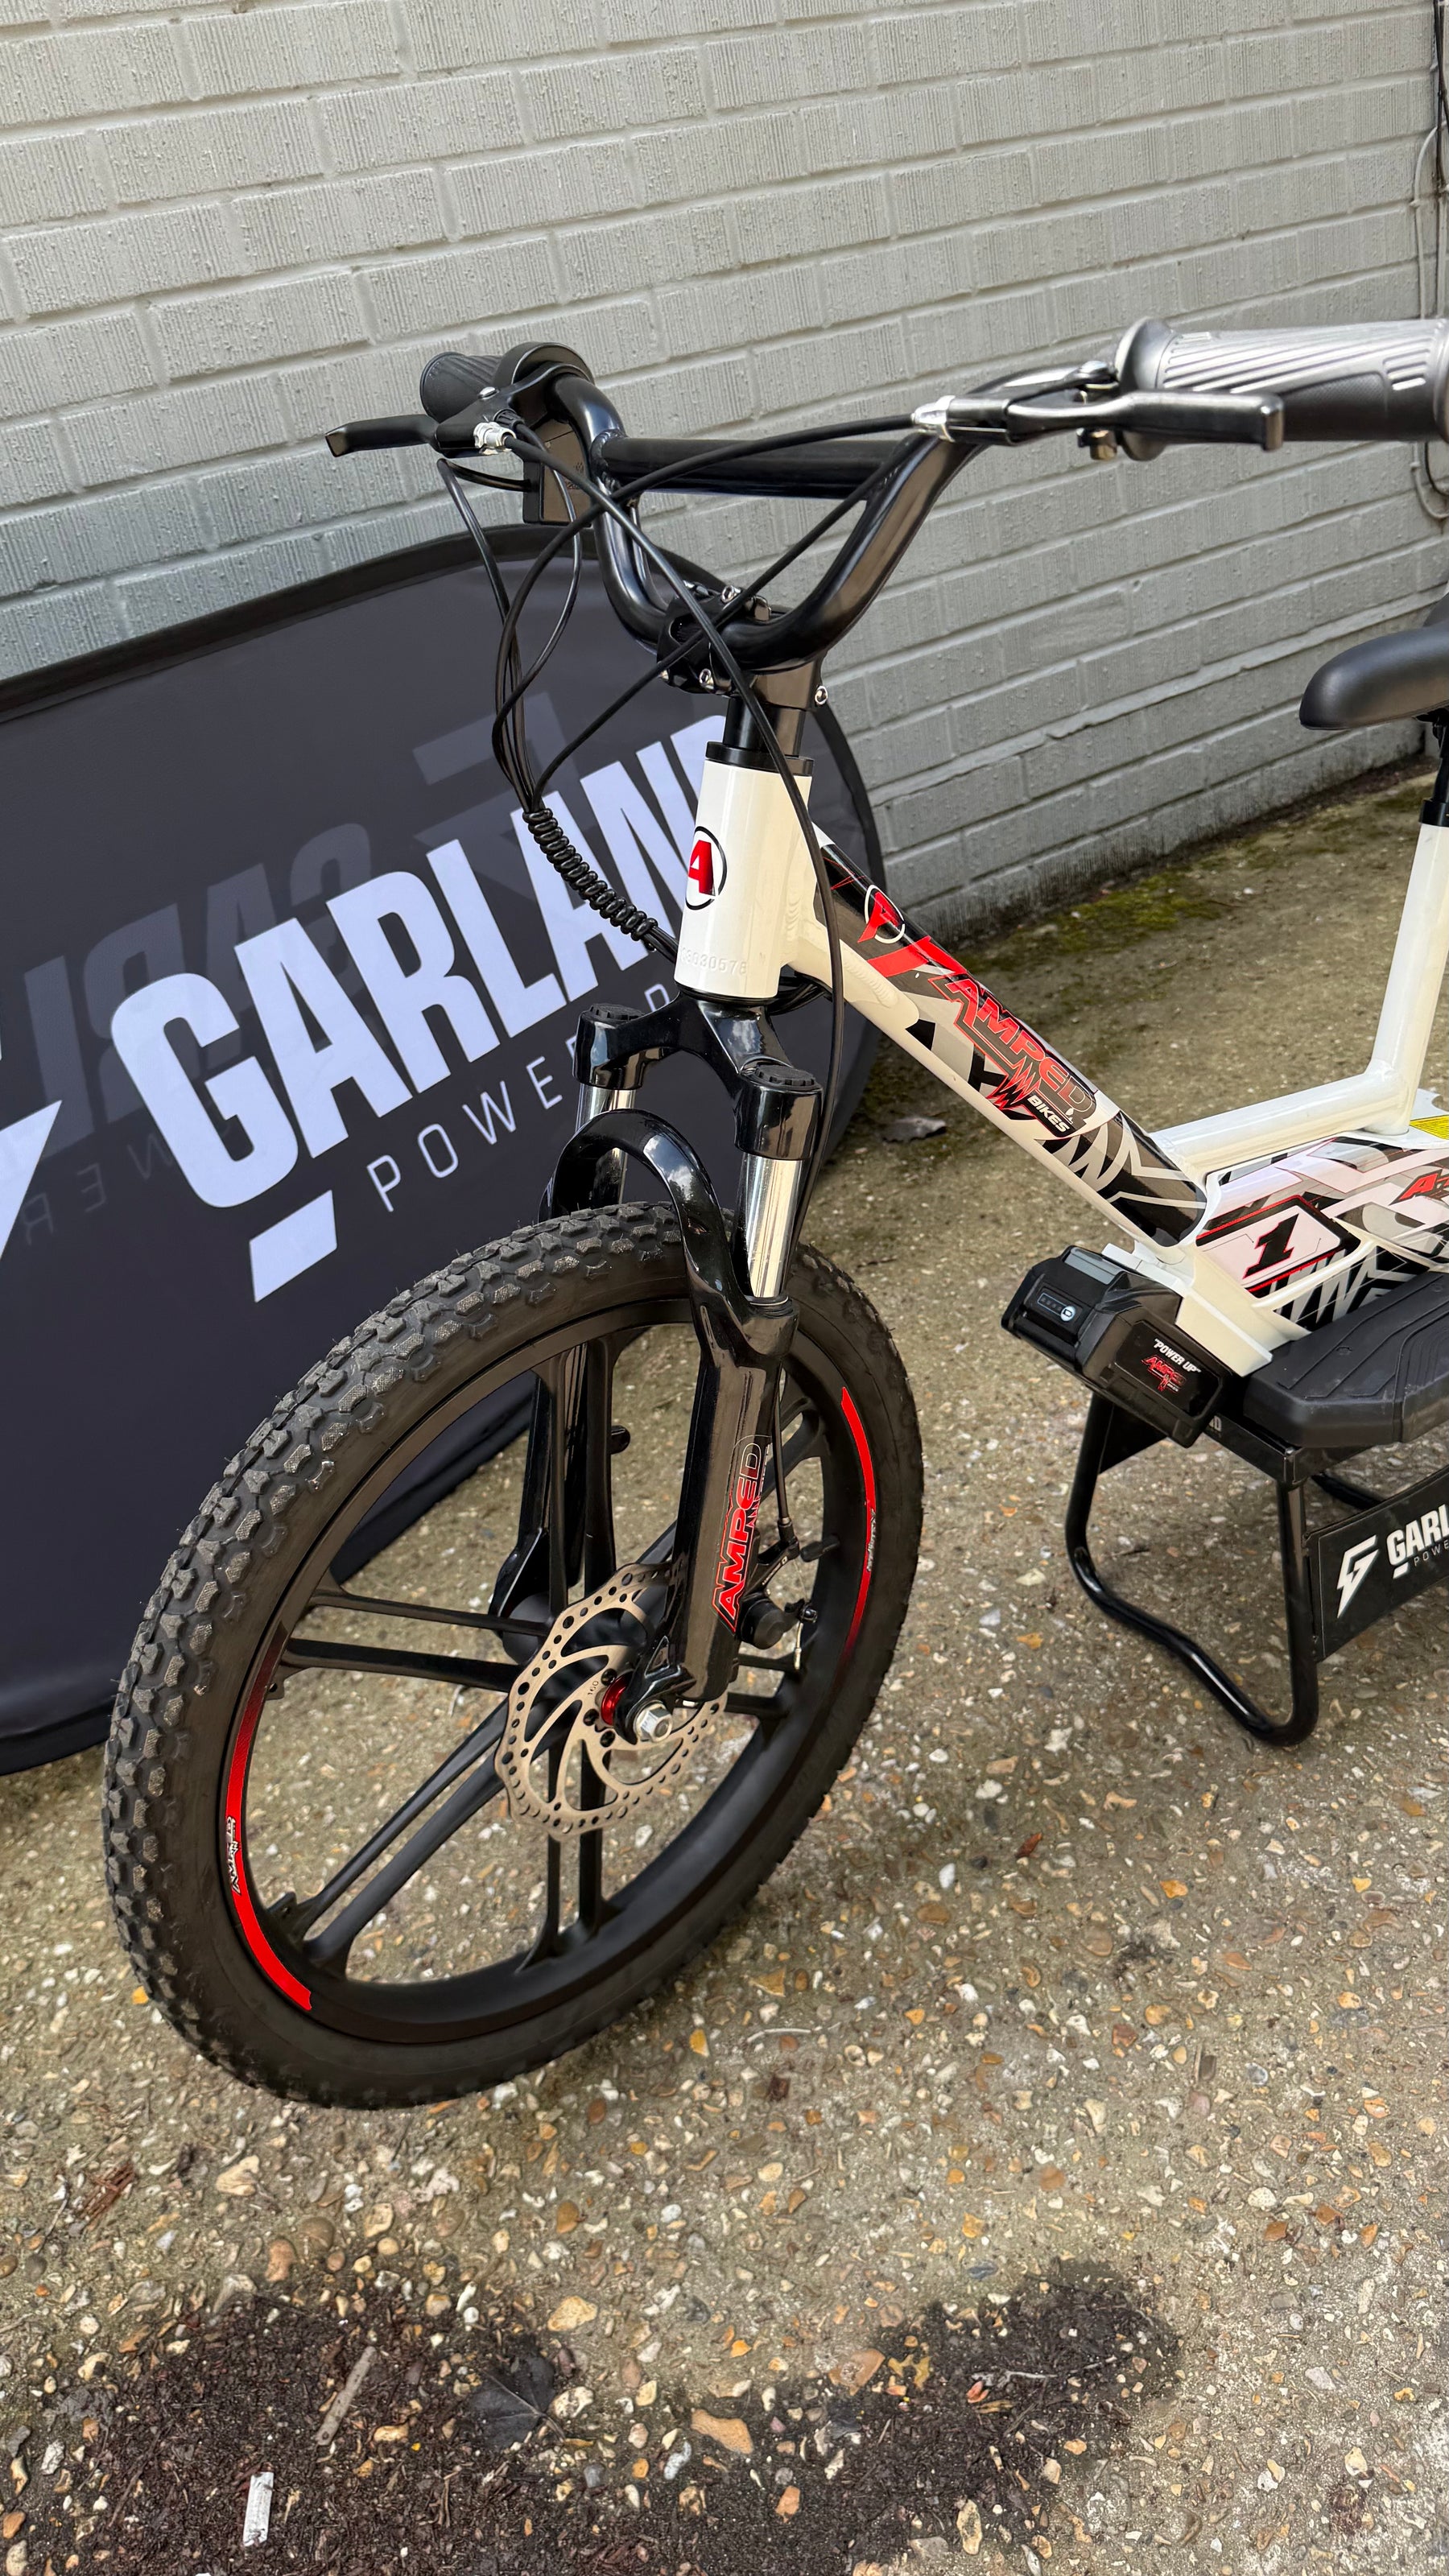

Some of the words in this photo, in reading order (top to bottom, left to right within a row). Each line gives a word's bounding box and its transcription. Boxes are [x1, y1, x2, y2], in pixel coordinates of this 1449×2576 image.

[945, 976, 1091, 1118] AMPED
[1026, 1093, 1071, 1133] BIKES
[366, 1033, 577, 1212] POWE
[1241, 1212, 1300, 1280] 1
[718, 1441, 762, 1621] AMPED
